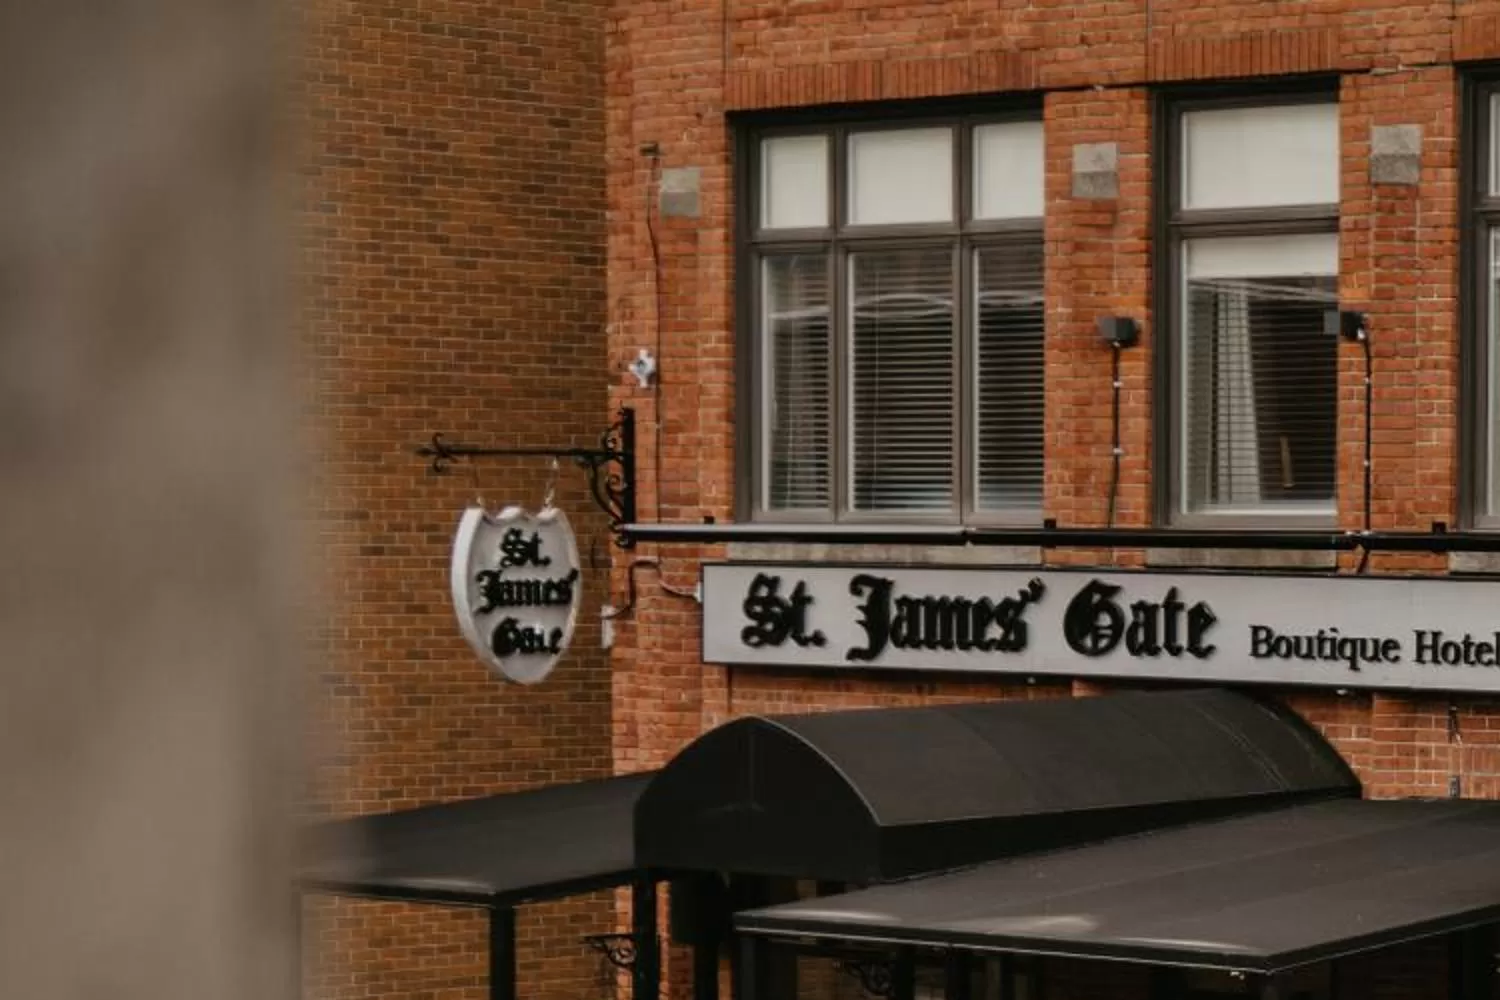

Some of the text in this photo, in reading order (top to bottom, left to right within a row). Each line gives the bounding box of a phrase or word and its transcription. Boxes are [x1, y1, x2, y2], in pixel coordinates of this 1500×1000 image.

[500, 527, 552, 569] St.
[740, 572, 1217, 662] St. James' Gate
[1248, 624, 1401, 671] Boutique
